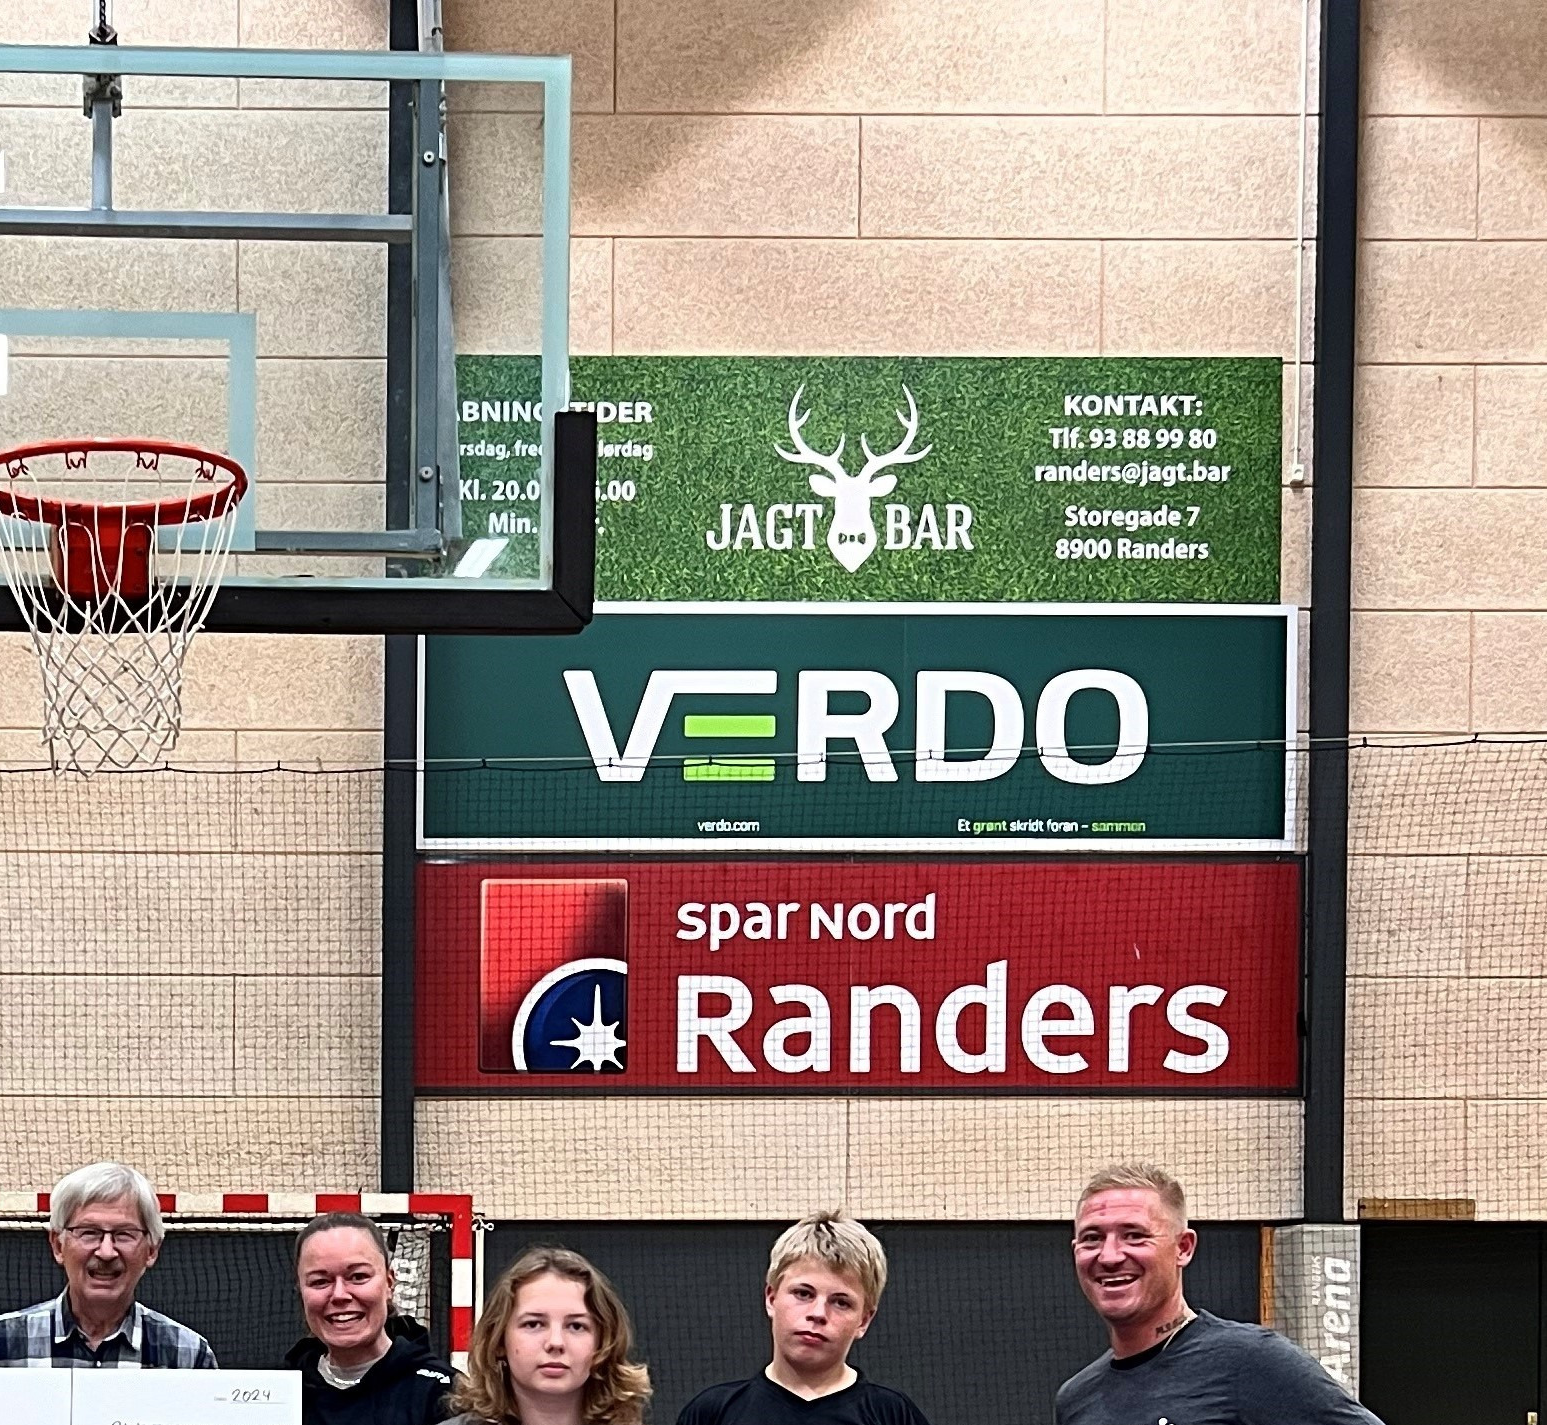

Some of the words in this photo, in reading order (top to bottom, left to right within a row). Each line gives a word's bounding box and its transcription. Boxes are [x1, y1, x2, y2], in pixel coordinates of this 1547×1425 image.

[1064, 394, 1203, 417] KONTAKT:
[1049, 426, 1085, 449] Tlf.
[1089, 427, 1117, 449] 93
[1121, 427, 1151, 449] 88
[1155, 427, 1184, 449] 99
[1188, 427, 1217, 449] 80
[598, 439, 654, 461] lørdag
[1034, 459, 1232, 488] randers@jagt.bar
[459, 479, 487, 501] Kl.
[488, 511, 539, 534] Min.
[705, 503, 823, 551] JAGT
[883, 503, 975, 551] BAR
[1064, 504, 1182, 532] Storegade
[1186, 505, 1201, 527] 7
[1055, 538, 1112, 560] 8900
[1117, 537, 1210, 560] Randers
[562, 667, 1150, 786] VERDO
[697, 818, 760, 833] verdo.com
[957, 818, 971, 833] Et
[972, 819, 1008, 836] grønt
[1009, 818, 1044, 834] skridt
[1045, 818, 1079, 834] foran
[676, 898, 800, 952] spar
[676, 958, 1231, 1076] Randers
[231, 1388, 271, 1402] 2024
